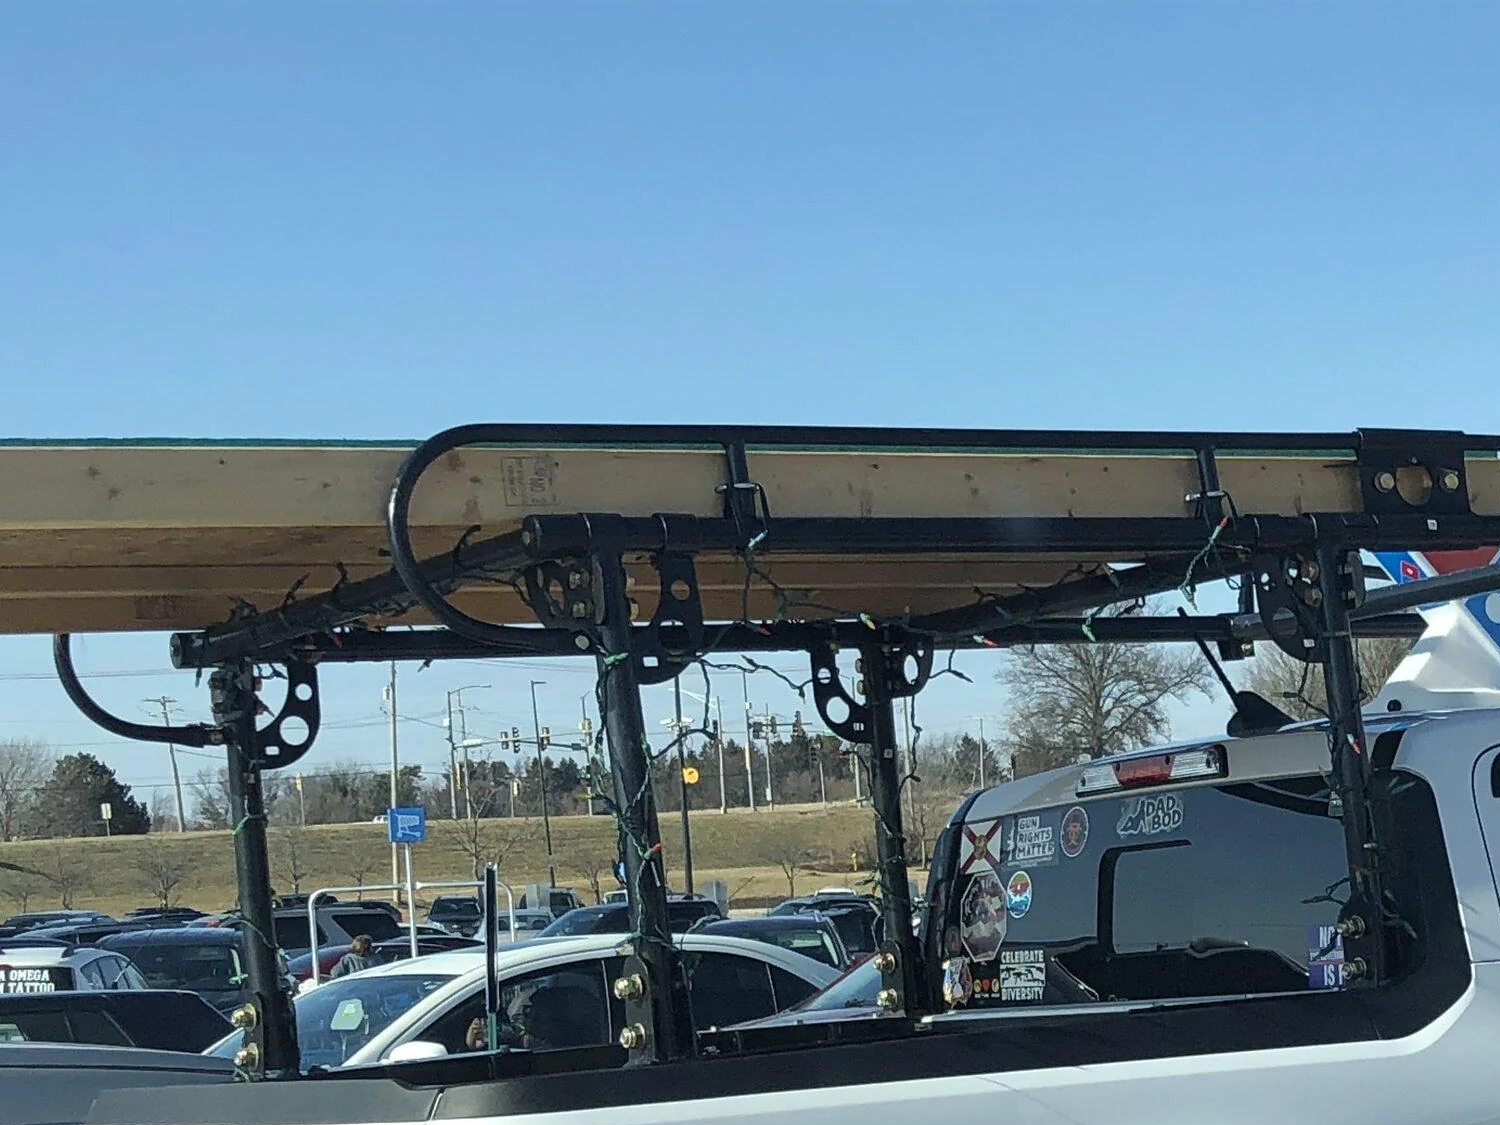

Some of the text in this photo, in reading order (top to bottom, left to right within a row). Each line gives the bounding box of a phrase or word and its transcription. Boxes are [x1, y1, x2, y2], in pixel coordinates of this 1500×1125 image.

[1146, 795, 1176, 817] DAD
[1019, 818, 1038, 830] GUN
[1152, 808, 1182, 831] BOD
[1018, 829, 1051, 844] RIGHTS
[1001, 949, 1044, 963] CELEBRATE
[9, 969, 50, 981] OMEGA
[7, 982, 55, 994] TATTOO
[1001, 987, 1044, 1001] DIVERSITY
